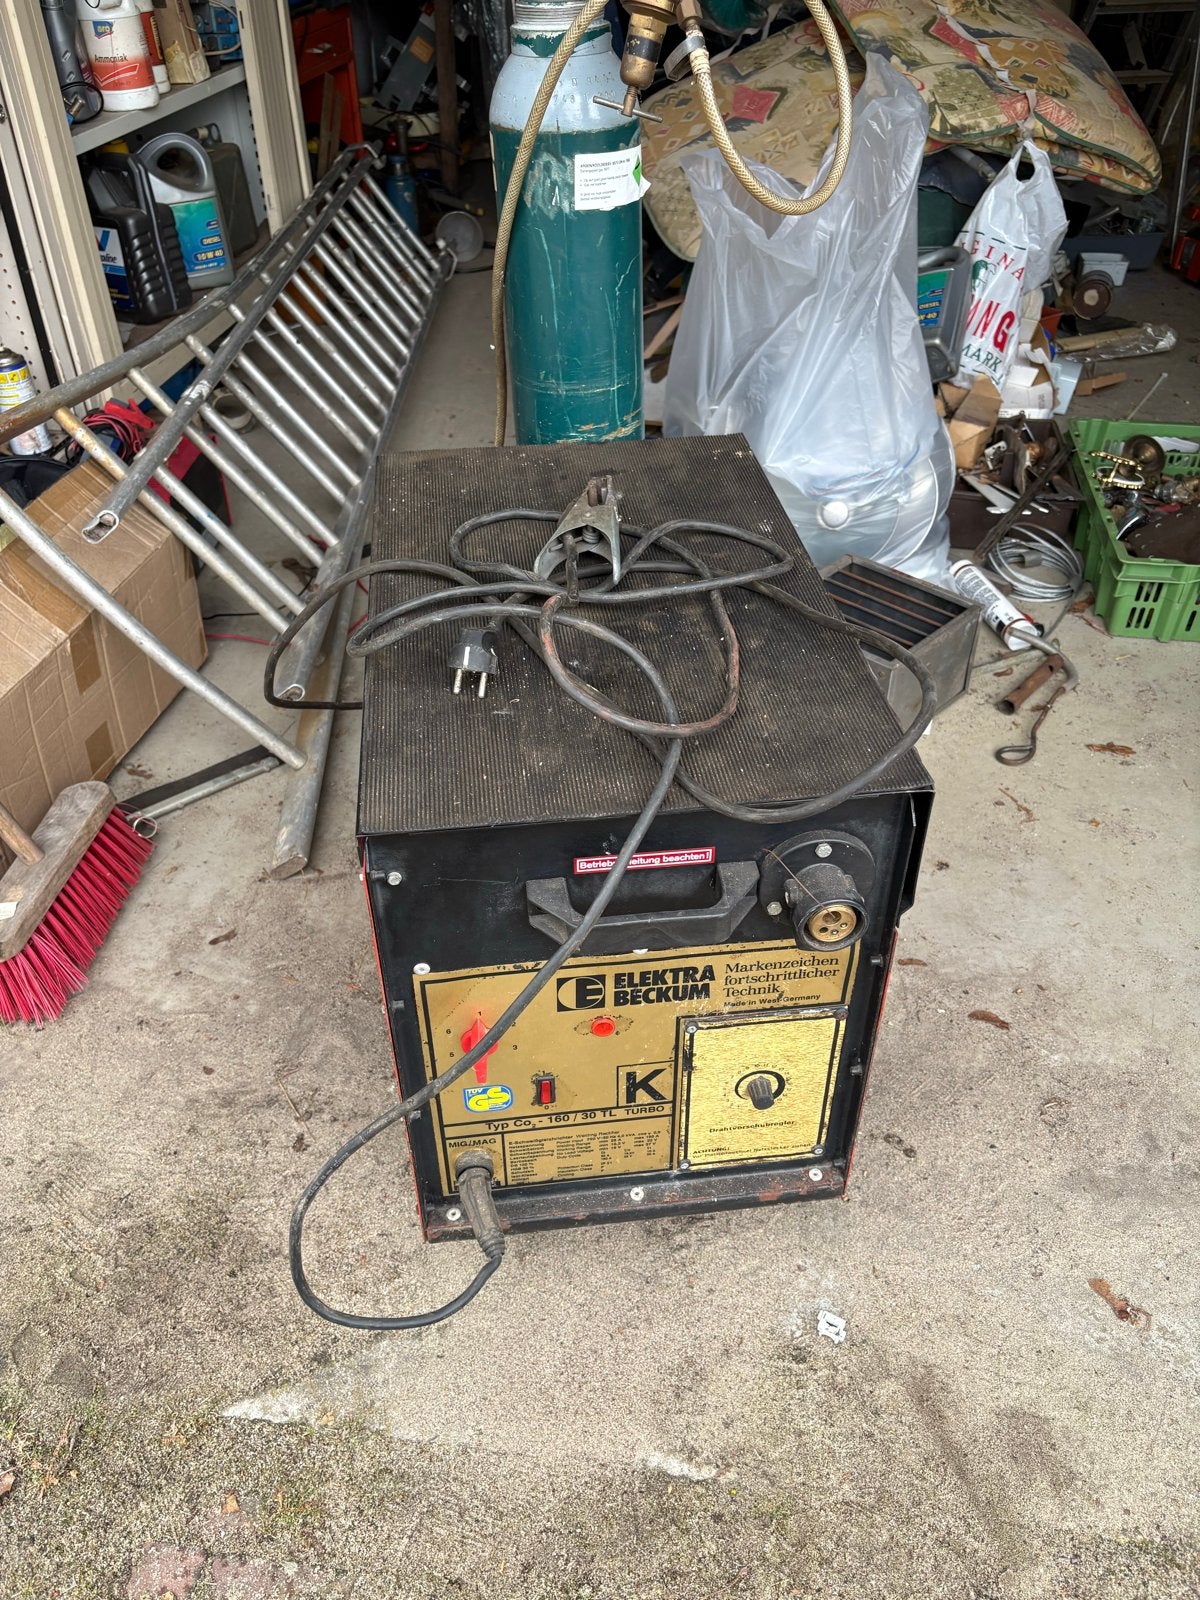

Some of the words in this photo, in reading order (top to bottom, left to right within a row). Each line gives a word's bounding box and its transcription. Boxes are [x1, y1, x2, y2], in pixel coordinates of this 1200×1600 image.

[94, 53, 128, 62] Ammoniak
[918, 302, 940, 310] DIESEL
[725, 956, 839, 974] Markenzeichen
[614, 964, 715, 990] ELEKTRA
[724, 967, 840, 986] fortschrittlicher
[614, 983, 710, 1007] BECKUM
[626, 1068, 667, 1104] K
[468, 1086, 511, 1111] GS
[486, 1122, 510, 1132] Typ
[547, 1114, 570, 1124] 160
[582, 1112, 597, 1120] 30
[601, 1110, 617, 1118] TL
[624, 1106, 665, 1116] TURBO
[448, 1138, 497, 1148] MIG/MAG
